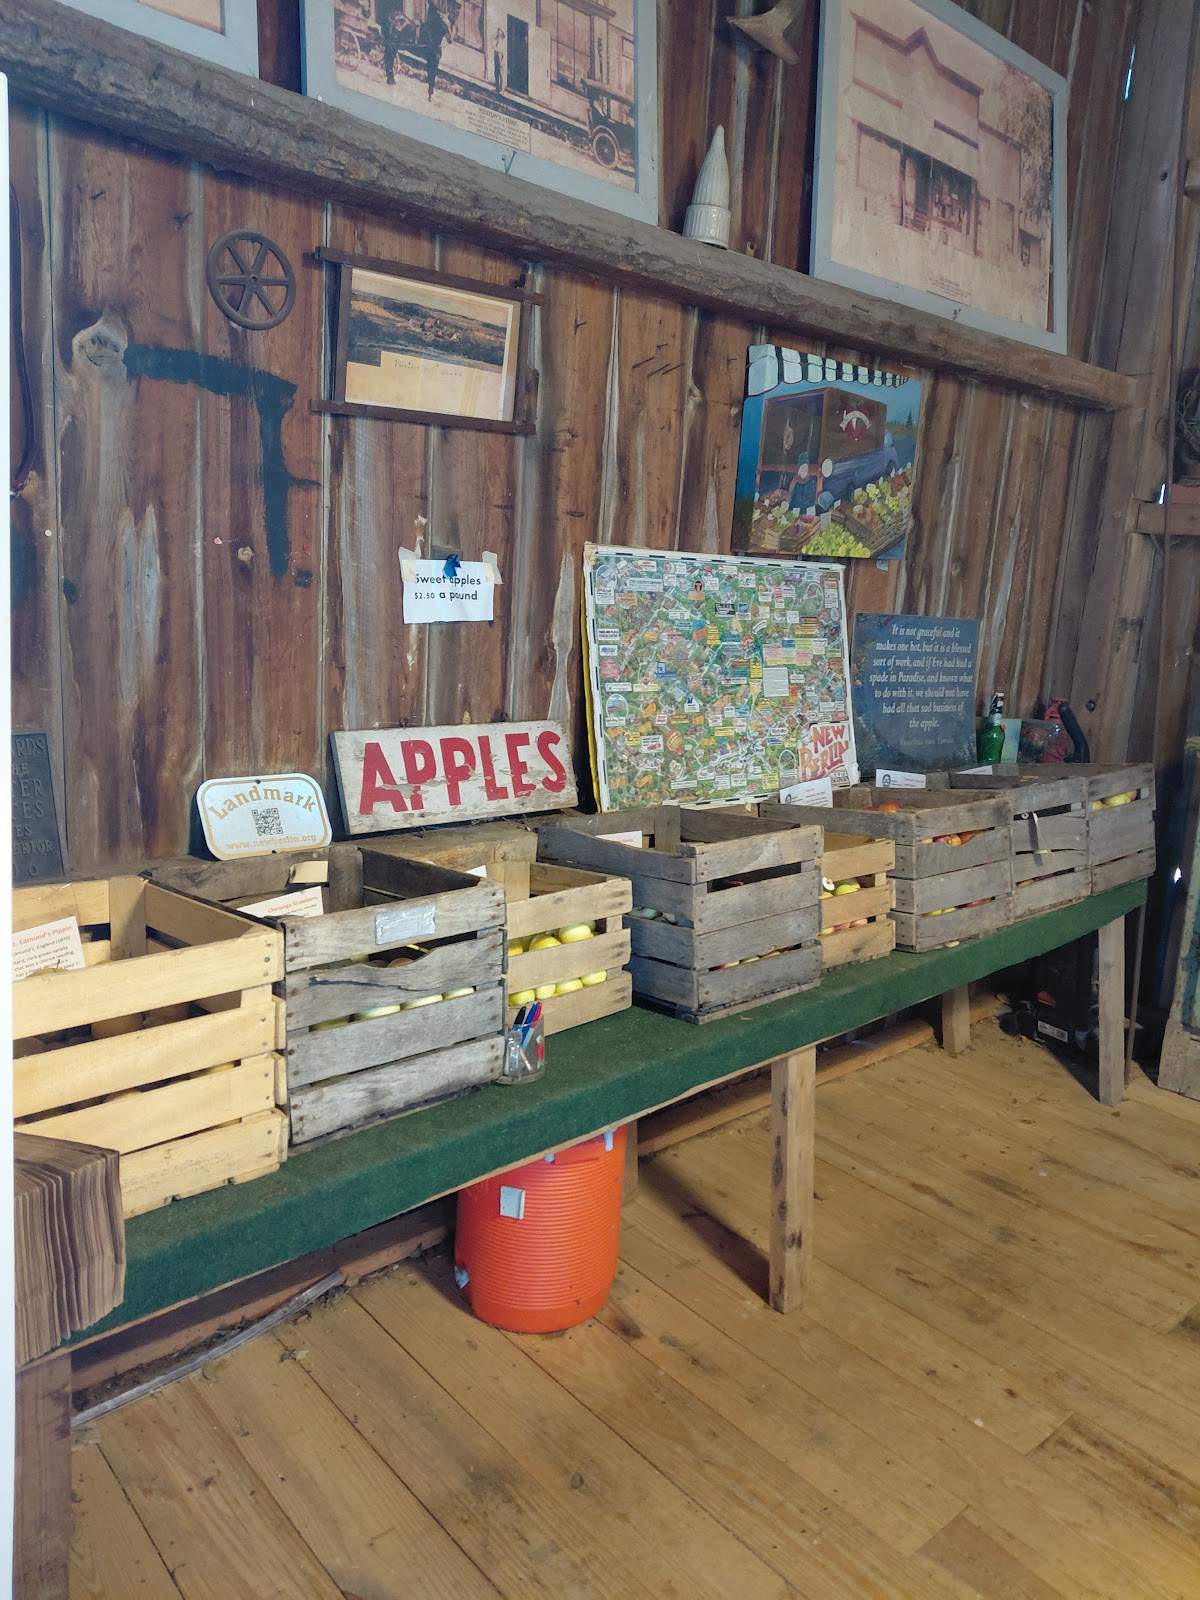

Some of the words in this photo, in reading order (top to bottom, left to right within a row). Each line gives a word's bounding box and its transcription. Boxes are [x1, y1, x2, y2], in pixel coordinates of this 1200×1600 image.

[414, 592, 435, 600] $2.50
[449, 590, 478, 601] pound
[943, 627, 954, 638] and
[887, 655, 896, 670] of
[811, 724, 846, 753] NEW
[359, 730, 567, 815] APPLES
[208, 785, 316, 820] Landmark
